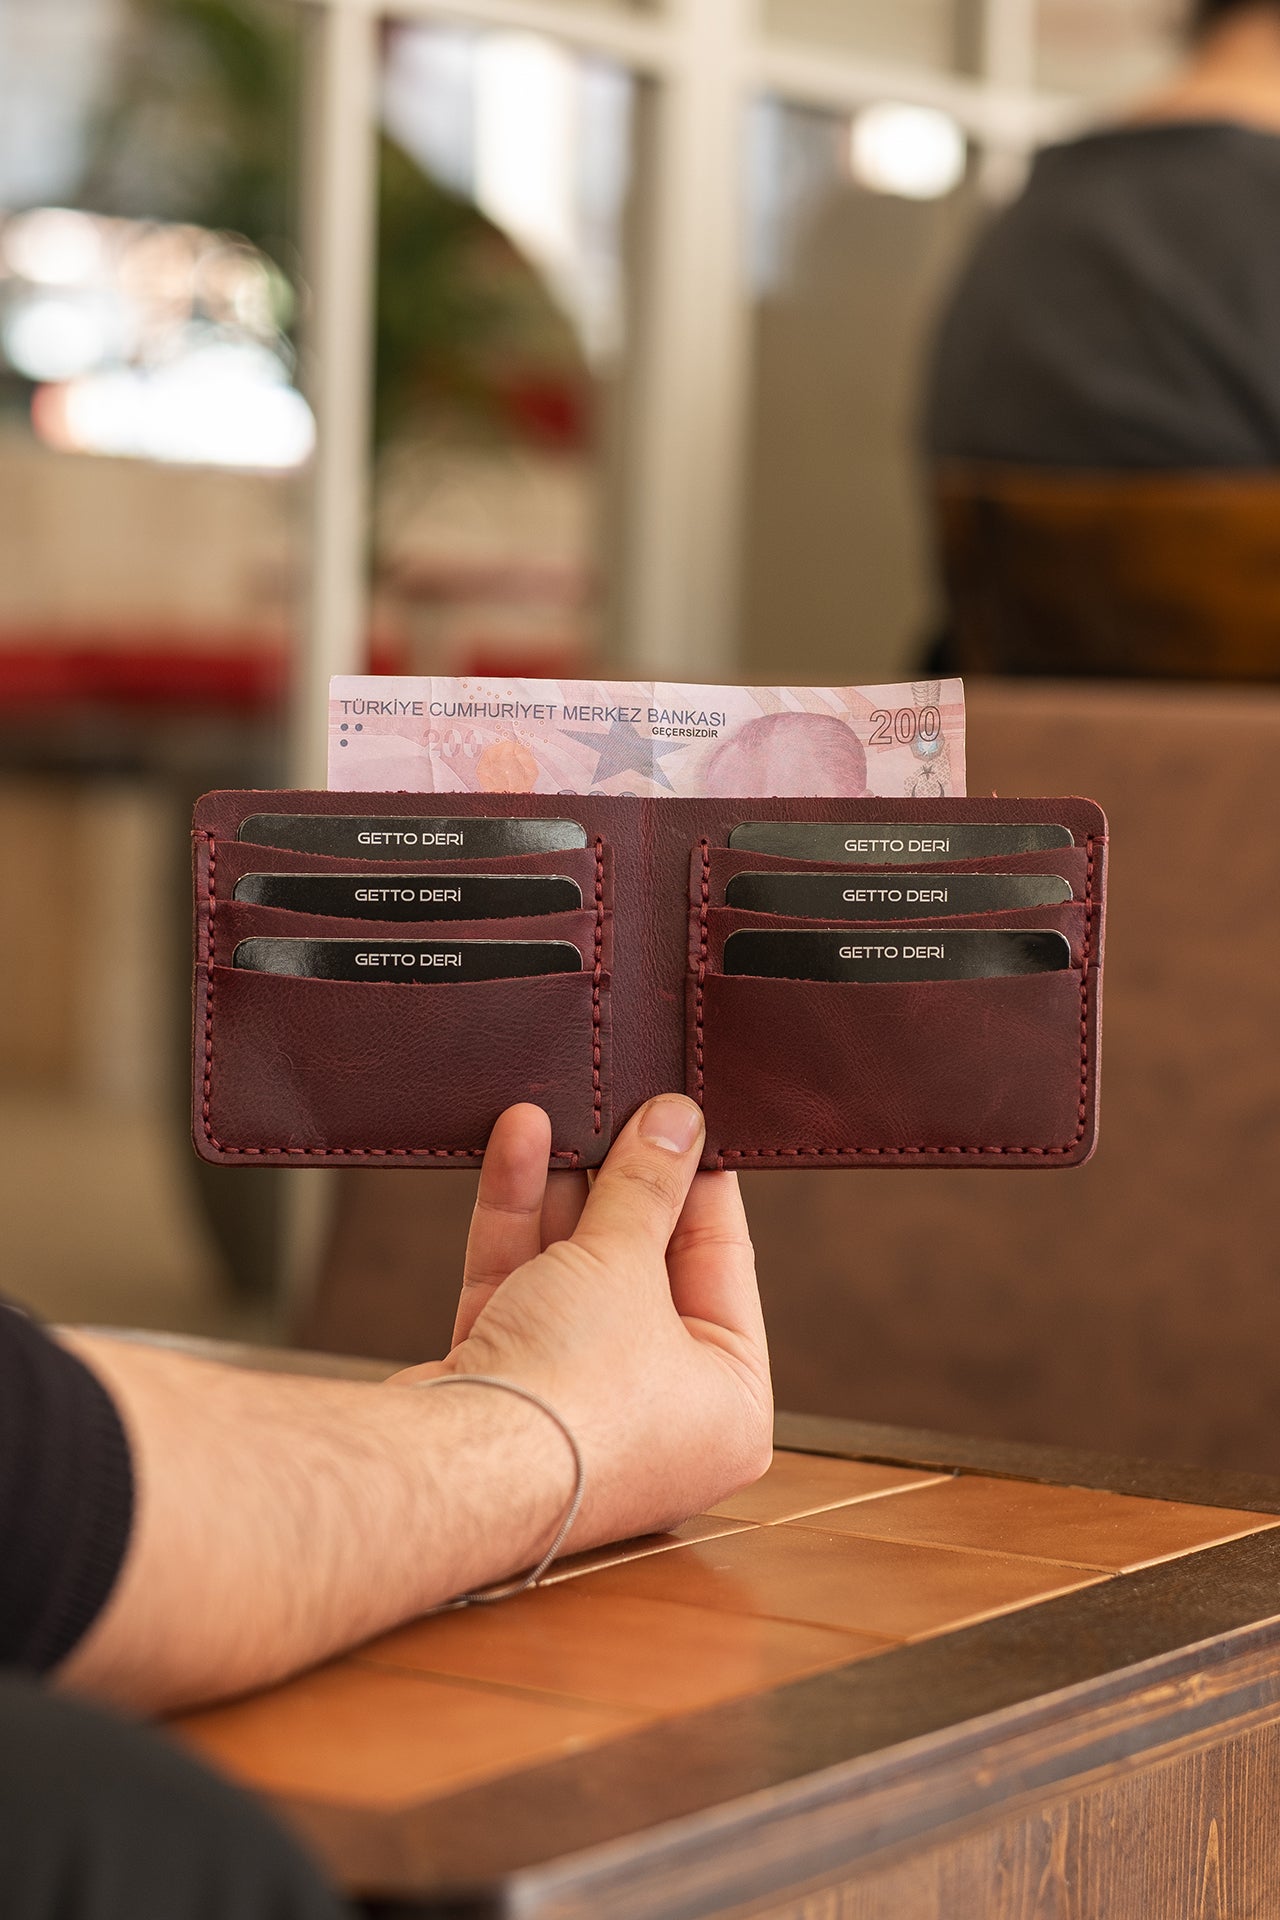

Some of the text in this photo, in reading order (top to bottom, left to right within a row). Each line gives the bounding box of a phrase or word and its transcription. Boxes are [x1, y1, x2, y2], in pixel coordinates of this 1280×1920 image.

[341, 698, 726, 727] TÜRKİYE CUMHURİYET MERKEZ BANKASI
[651, 726, 718, 738] GEÇERSİZDİR
[868, 705, 941, 746] 200
[358, 830, 464, 846] GETTO DERİ
[845, 837, 950, 853] GETTO DERİ
[355, 887, 462, 902] GETTO DERİ
[842, 887, 948, 903] GETTO DERİ
[355, 951, 462, 967] GETTO DERİ
[838, 944, 945, 959] GETTO DERİ
